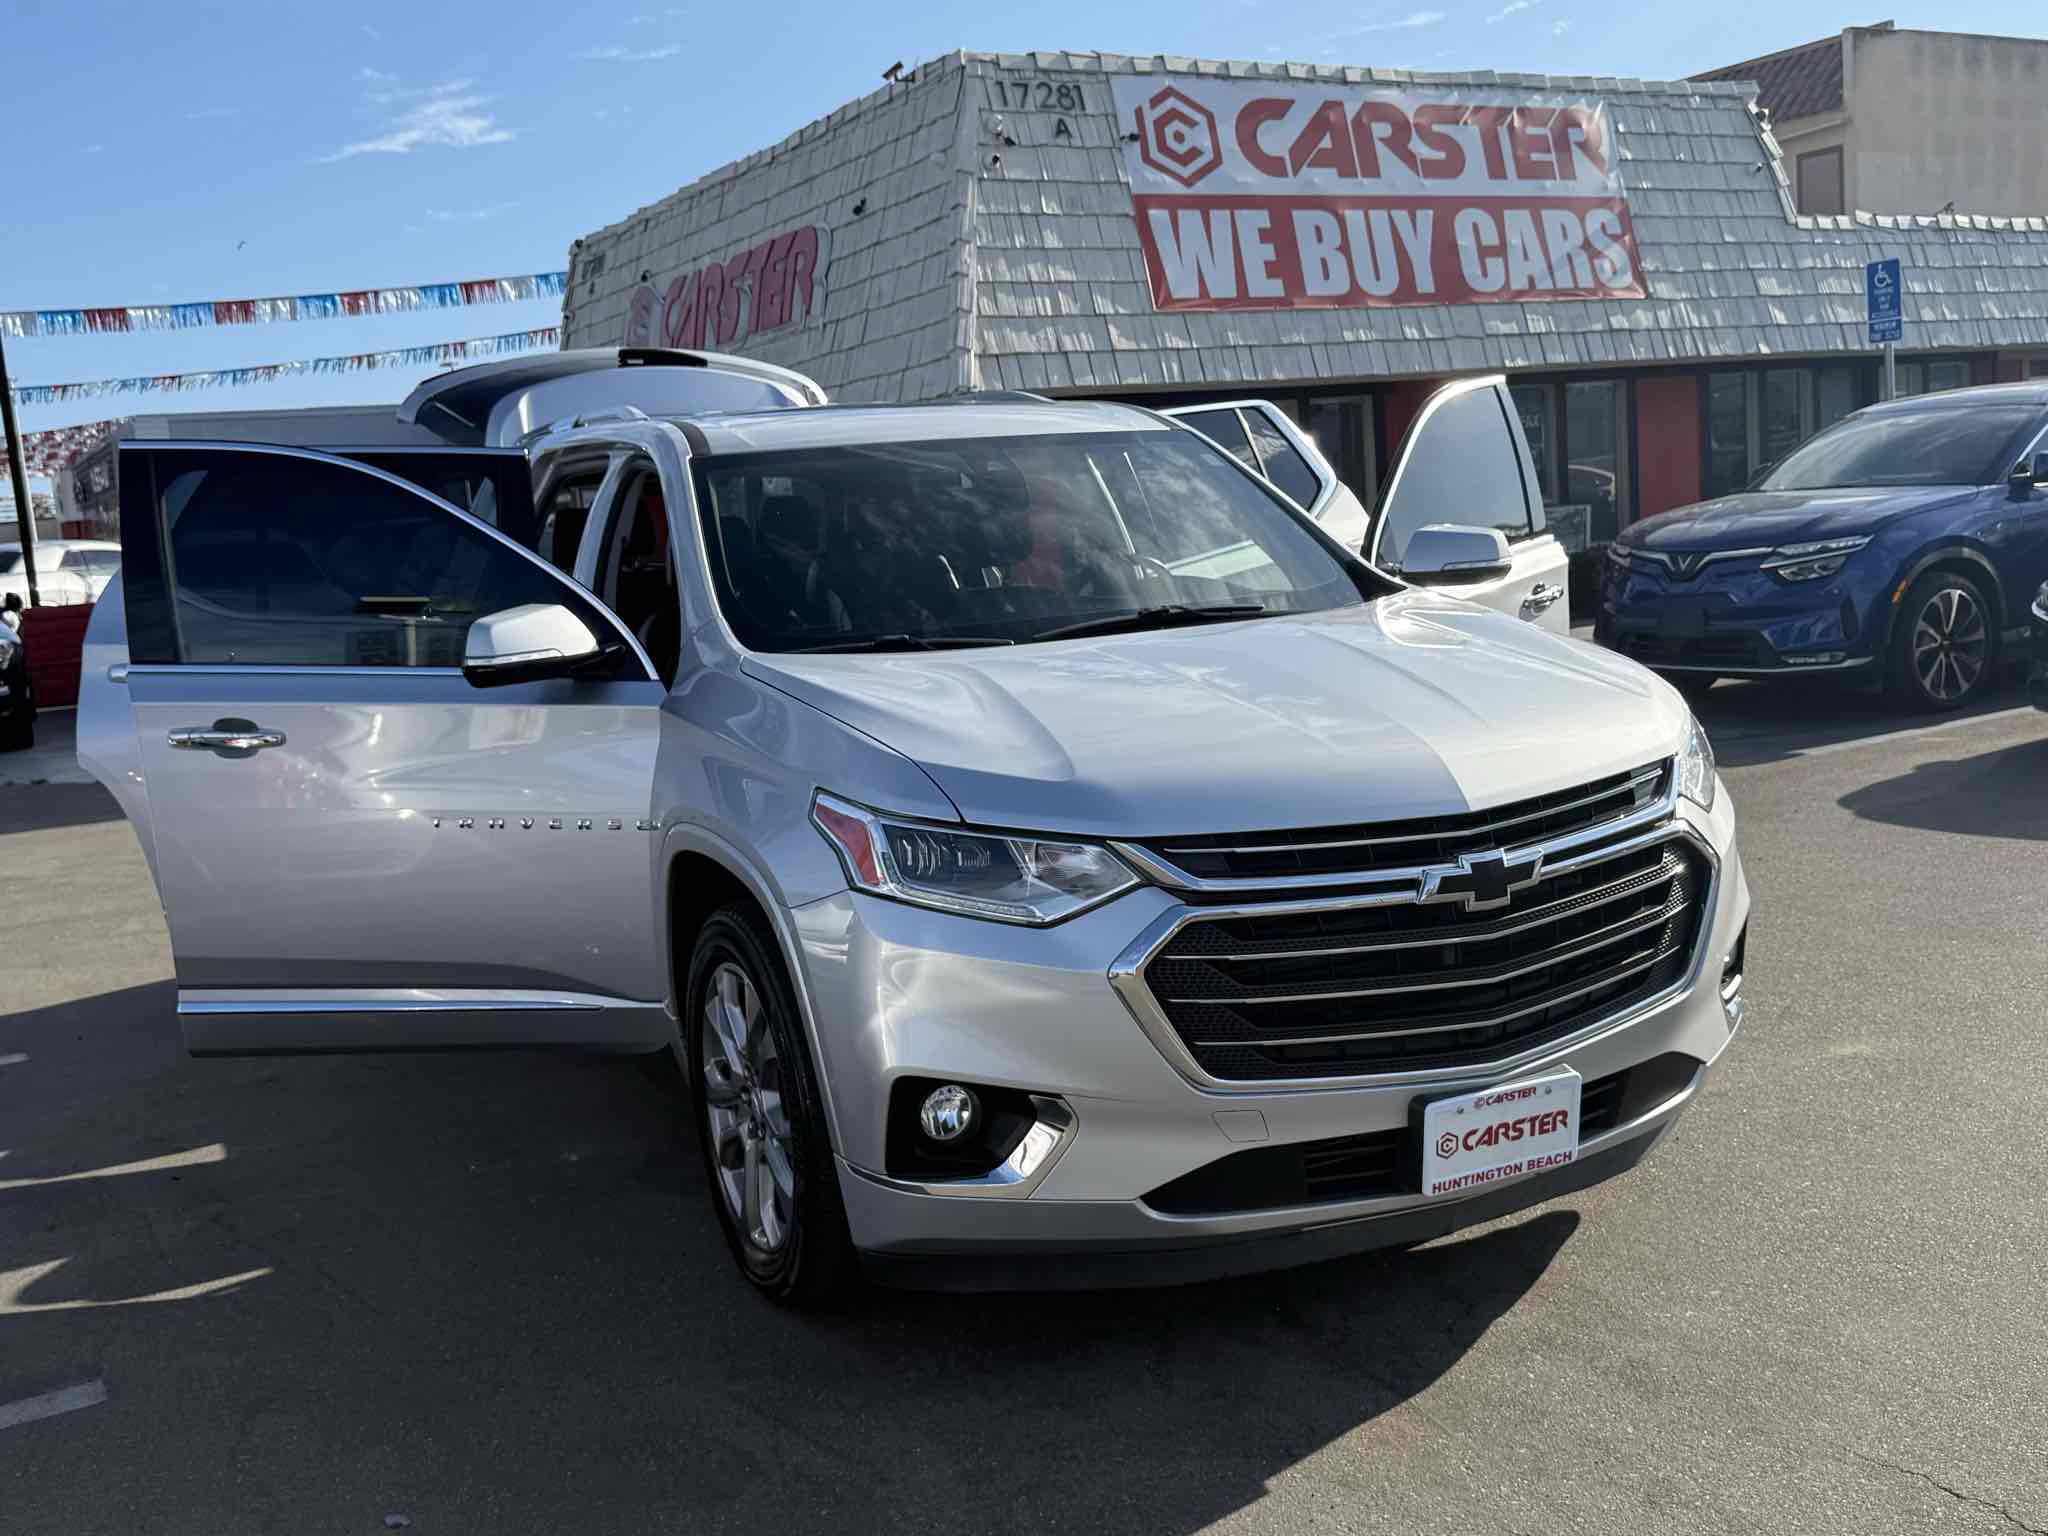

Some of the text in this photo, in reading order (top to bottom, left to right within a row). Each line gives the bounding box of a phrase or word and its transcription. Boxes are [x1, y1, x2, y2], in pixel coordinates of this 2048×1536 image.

[995, 81, 1086, 112] 17281
[1055, 118, 1073, 145] A
[1235, 98, 1607, 180] CARSTER
[1147, 207, 1633, 299] WE BUY CARS
[663, 224, 818, 350] CARSTER
[1486, 1086, 1537, 1107] CARSTER
[1462, 1109, 1568, 1151] CARSTER
[1431, 1150, 1573, 1194] HUNTINGTON BEACH
